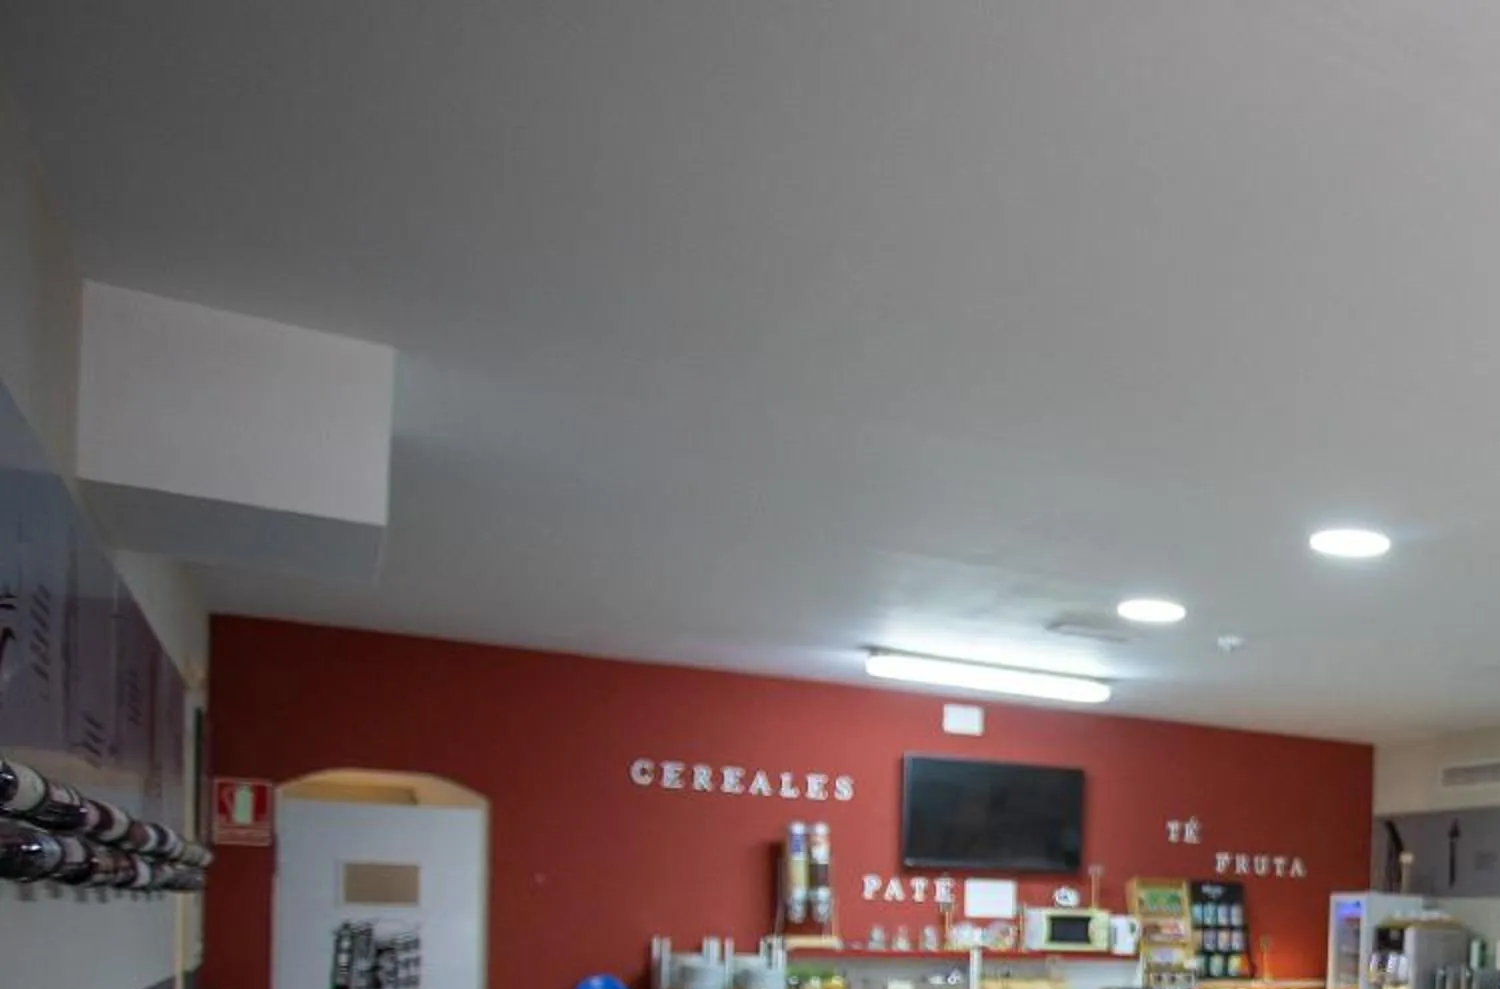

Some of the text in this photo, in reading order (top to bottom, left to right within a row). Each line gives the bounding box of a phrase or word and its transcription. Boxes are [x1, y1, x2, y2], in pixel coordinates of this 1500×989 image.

[630, 757, 854, 801] CEREALES
[1166, 816, 1200, 844] TÉ
[1215, 852, 1307, 878] FRUTA
